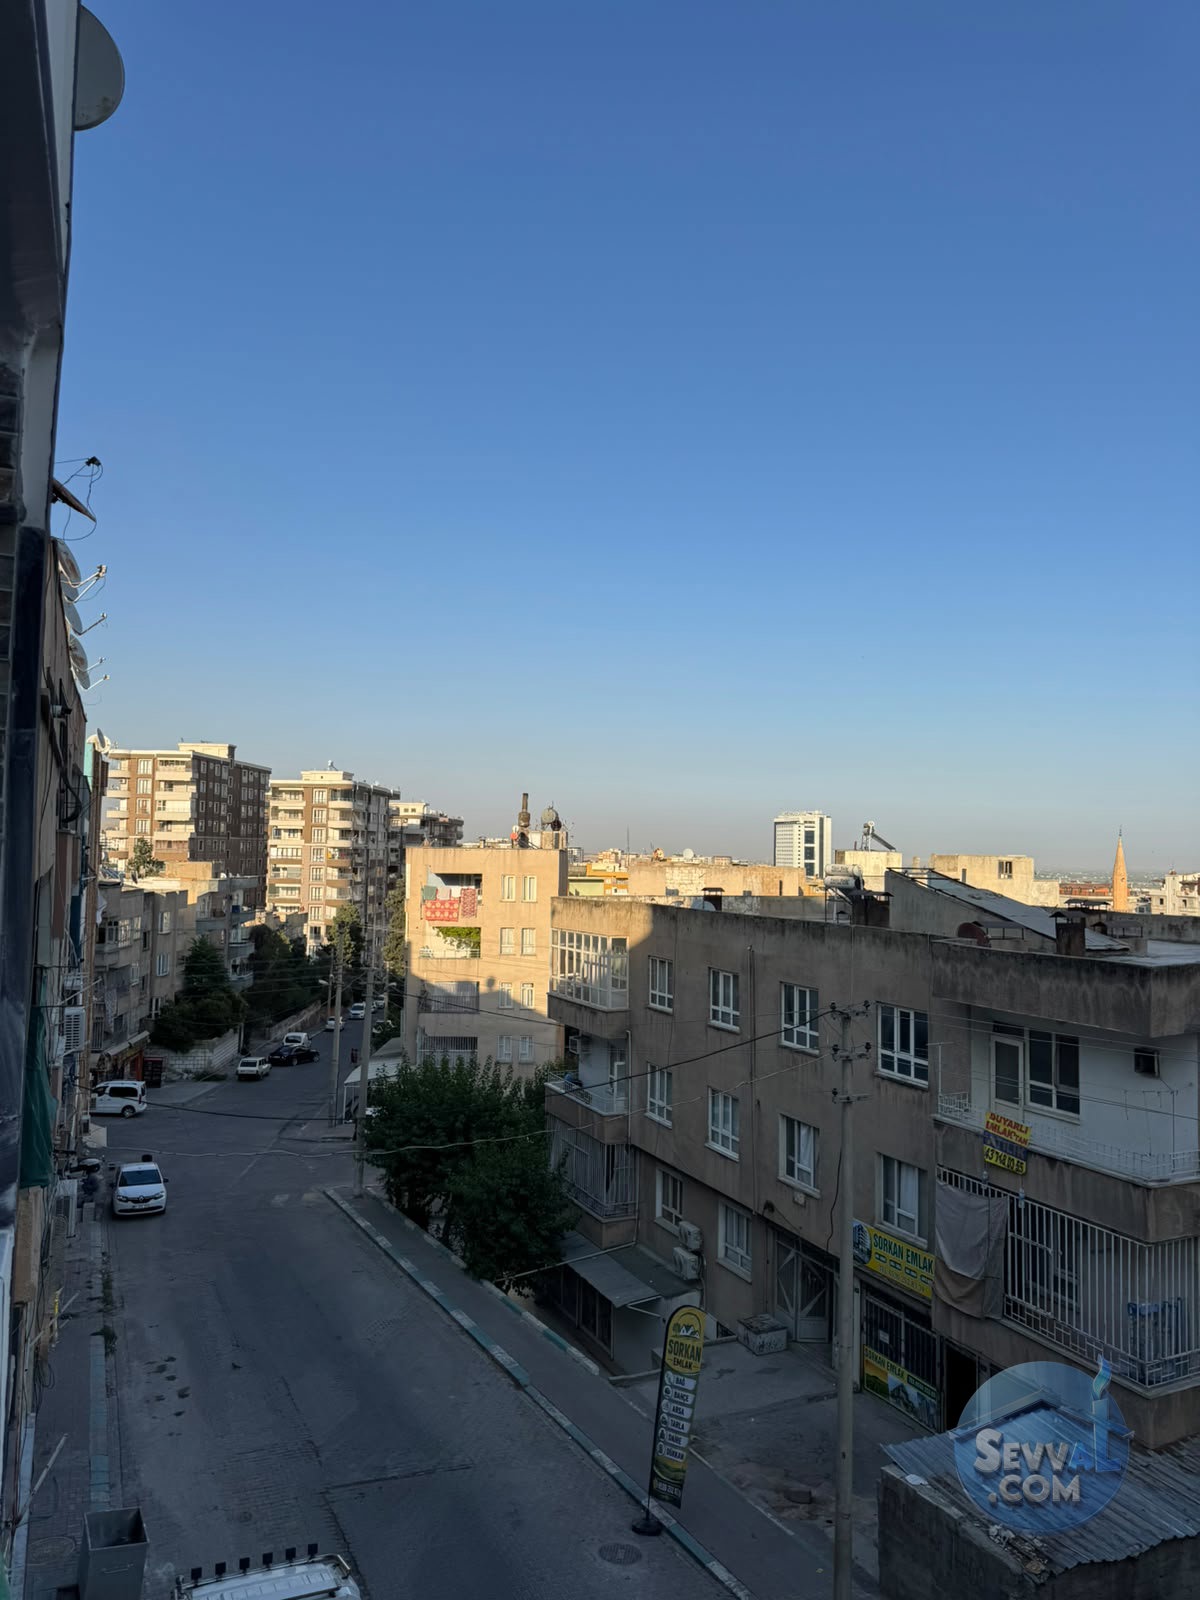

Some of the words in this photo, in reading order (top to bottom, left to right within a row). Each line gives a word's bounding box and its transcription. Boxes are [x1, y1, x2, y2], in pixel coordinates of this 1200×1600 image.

[989, 1112, 1029, 1134] DUYARLI
[873, 1233, 904, 1260] SORKAN
[905, 1248, 934, 1275] EMLAK
[667, 1339, 702, 1363] SORKAN
[672, 1357, 693, 1370] EMLAK
[672, 1404, 685, 1416] ARSA
[670, 1418, 685, 1430] TARLA
